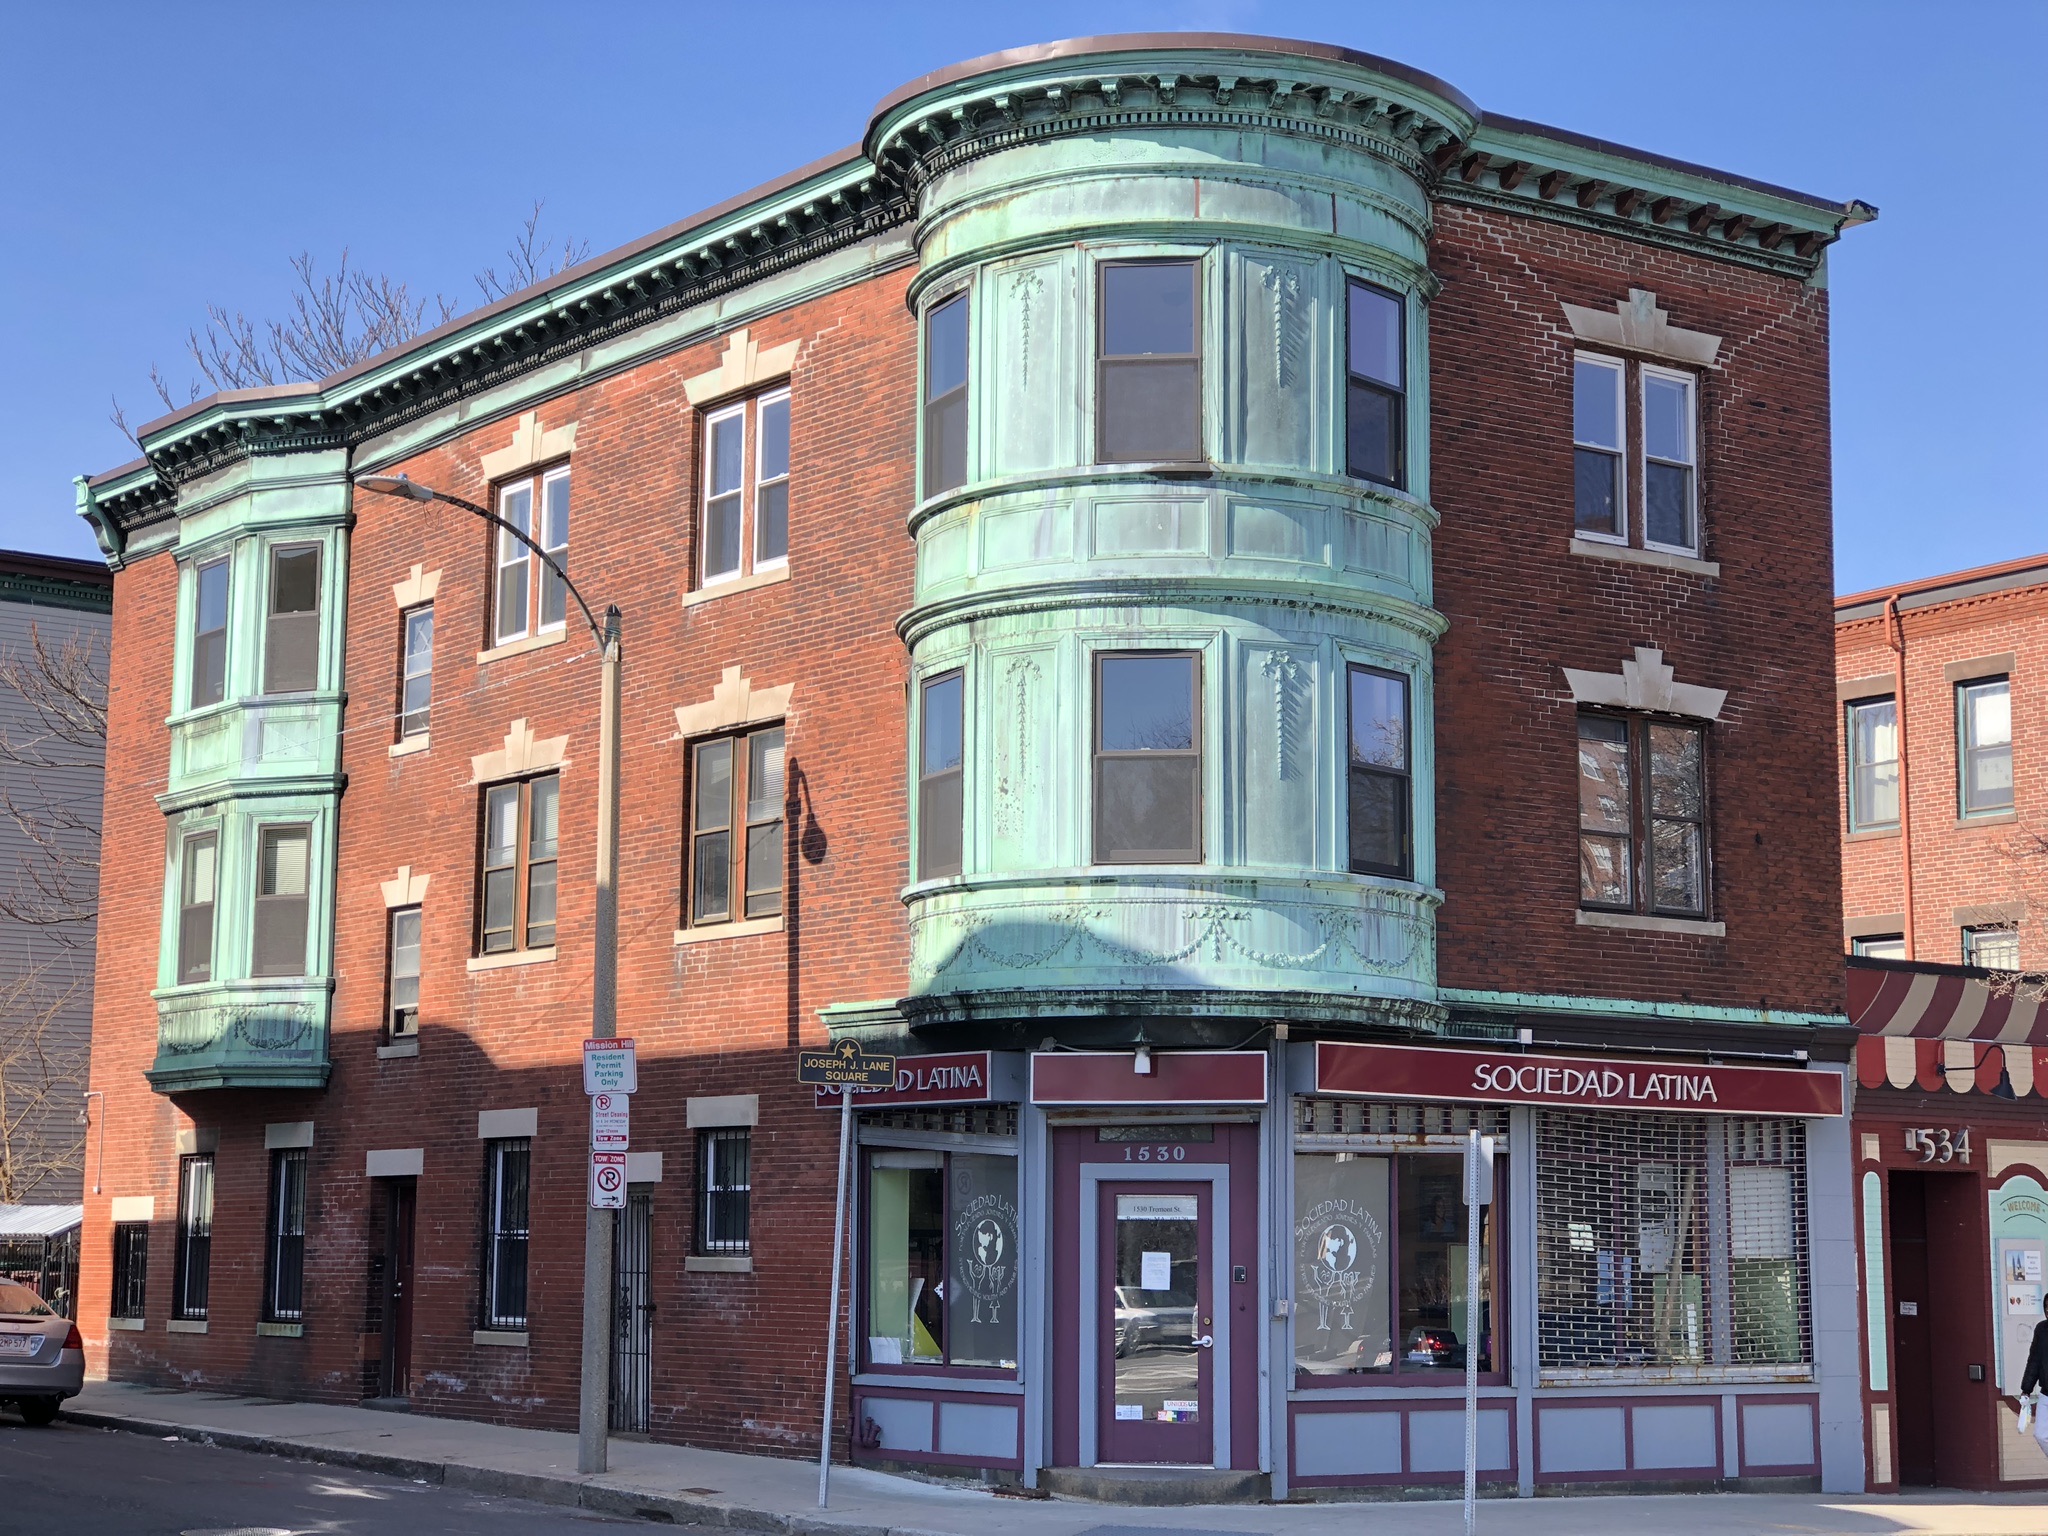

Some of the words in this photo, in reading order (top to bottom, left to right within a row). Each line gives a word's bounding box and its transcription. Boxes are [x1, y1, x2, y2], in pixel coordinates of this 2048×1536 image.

[585, 1041, 618, 1049] Mission
[621, 1040, 634, 1048] Hill
[804, 1058, 846, 1069] JOSEPH
[850, 1060, 858, 1070] J.
[863, 1061, 890, 1071] LANE
[594, 1070, 624, 1078] Parking
[825, 1071, 868, 1081] SQUARE
[917, 1065, 983, 1091] LATINA
[1471, 1064, 1624, 1098] SOCIEDAD
[1628, 1072, 1718, 1102] LATINA
[1902, 1127, 1972, 1164] 1534
[595, 1155, 608, 1163] TOW
[610, 1155, 625, 1163] ZONE
[1124, 1146, 1185, 1161] 1530
[2007, 1200, 2042, 1214] WELCOME
[955, 1194, 996, 1237] SOCIEDAD
[998, 1194, 1018, 1229] LATI
[1295, 1199, 1348, 1242] SOCIEDAD
[1350, 1199, 1382, 1244] LATINA
[14, 1339, 27, 1348] 577
